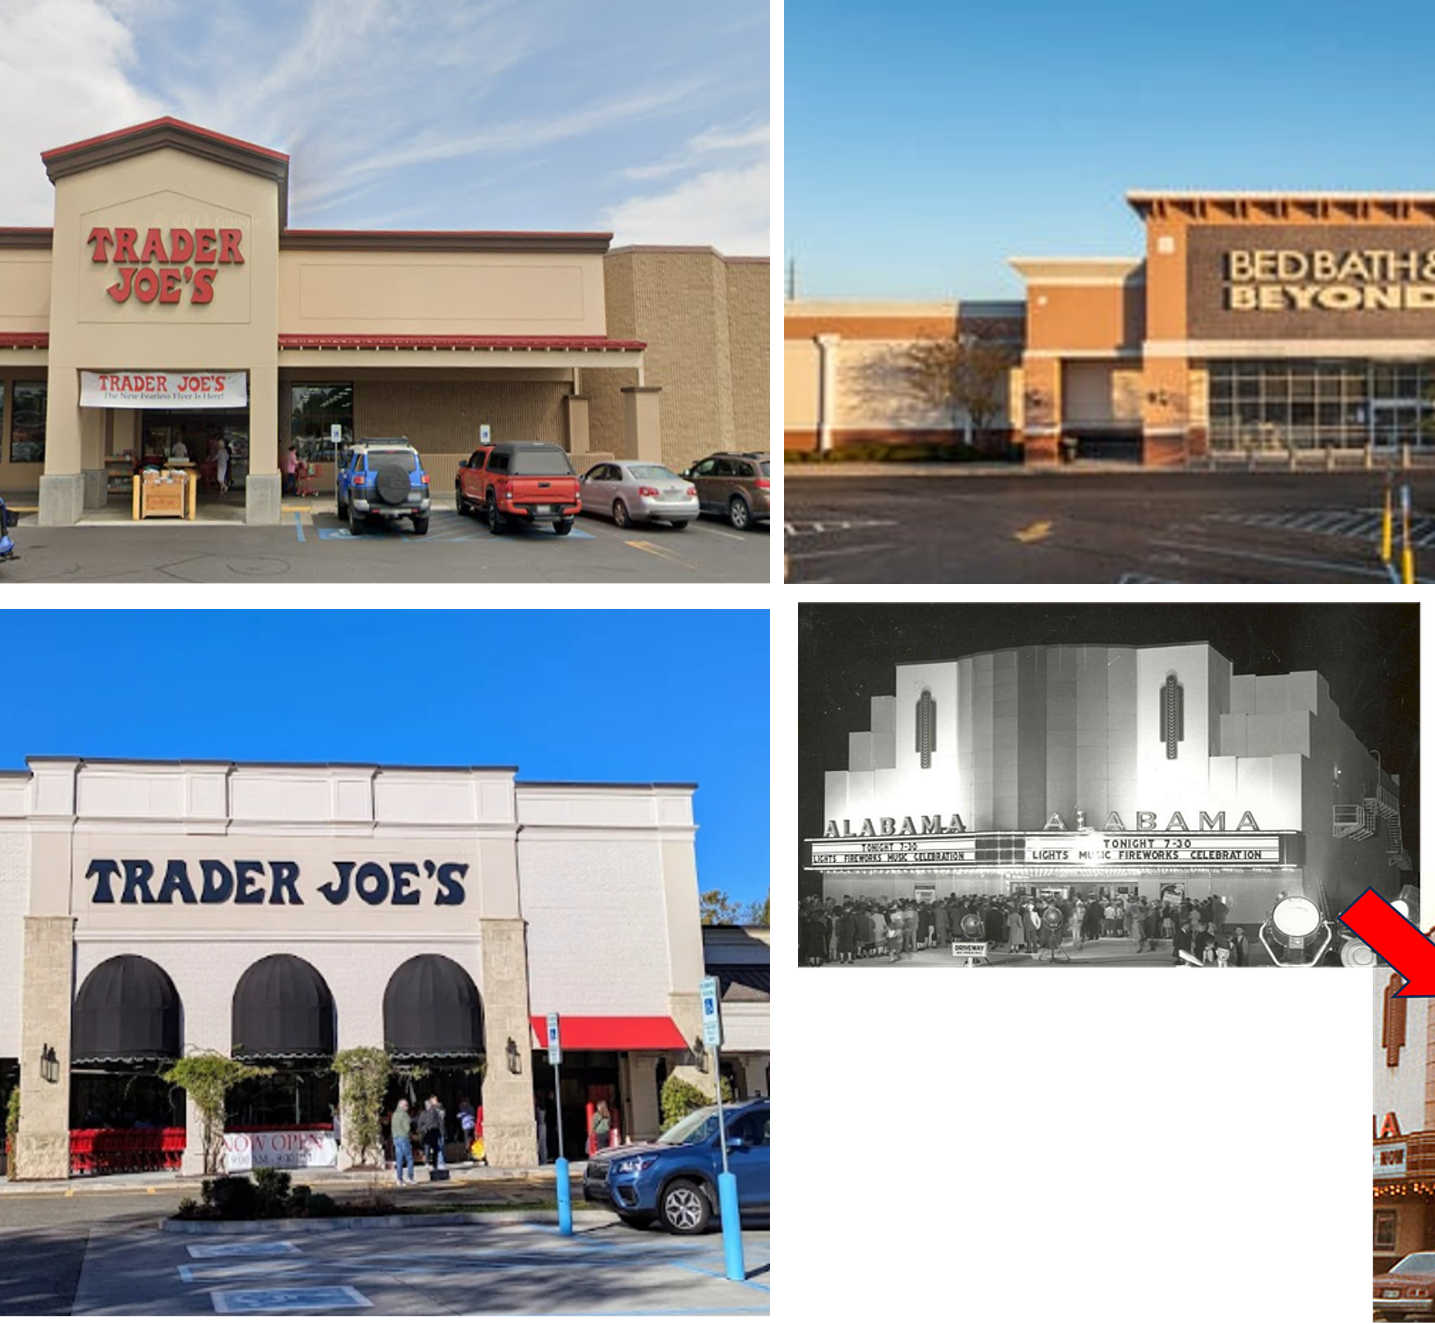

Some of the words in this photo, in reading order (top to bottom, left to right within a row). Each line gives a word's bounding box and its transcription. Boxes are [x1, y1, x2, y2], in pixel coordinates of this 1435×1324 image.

[87, 227, 245, 264] TRADER
[1229, 250, 1309, 281] BED
[1313, 250, 1418, 281] BATH
[106, 266, 218, 304] JOE'S
[98, 375, 168, 392] TRADER
[177, 375, 226, 392] JOE'S
[120, 392, 138, 400] New
[140, 392, 171, 400] Fearless
[173, 392, 192, 402] Flyer
[823, 814, 966, 838] ALABAMA
[1043, 811, 1260, 831] ALABAMA
[861, 843, 894, 853] TONIGHT
[1103, 839, 1155, 849] TONIGHT
[1164, 839, 1192, 848] 7-30
[813, 855, 837, 863] LIGHTS
[844, 854, 882, 863] FIREWORKS
[887, 853, 908, 862] MUSIC
[913, 852, 965, 861] CELEBRATION
[1032, 850, 1069, 860] LIGHTS
[1119, 850, 1179, 860] FIREWORKS
[1190, 850, 1262, 860] CELEBRATION
[85, 859, 304, 904] TRADER
[317, 860, 469, 906] JOE'S
[271, 1132, 324, 1151] OPEN
